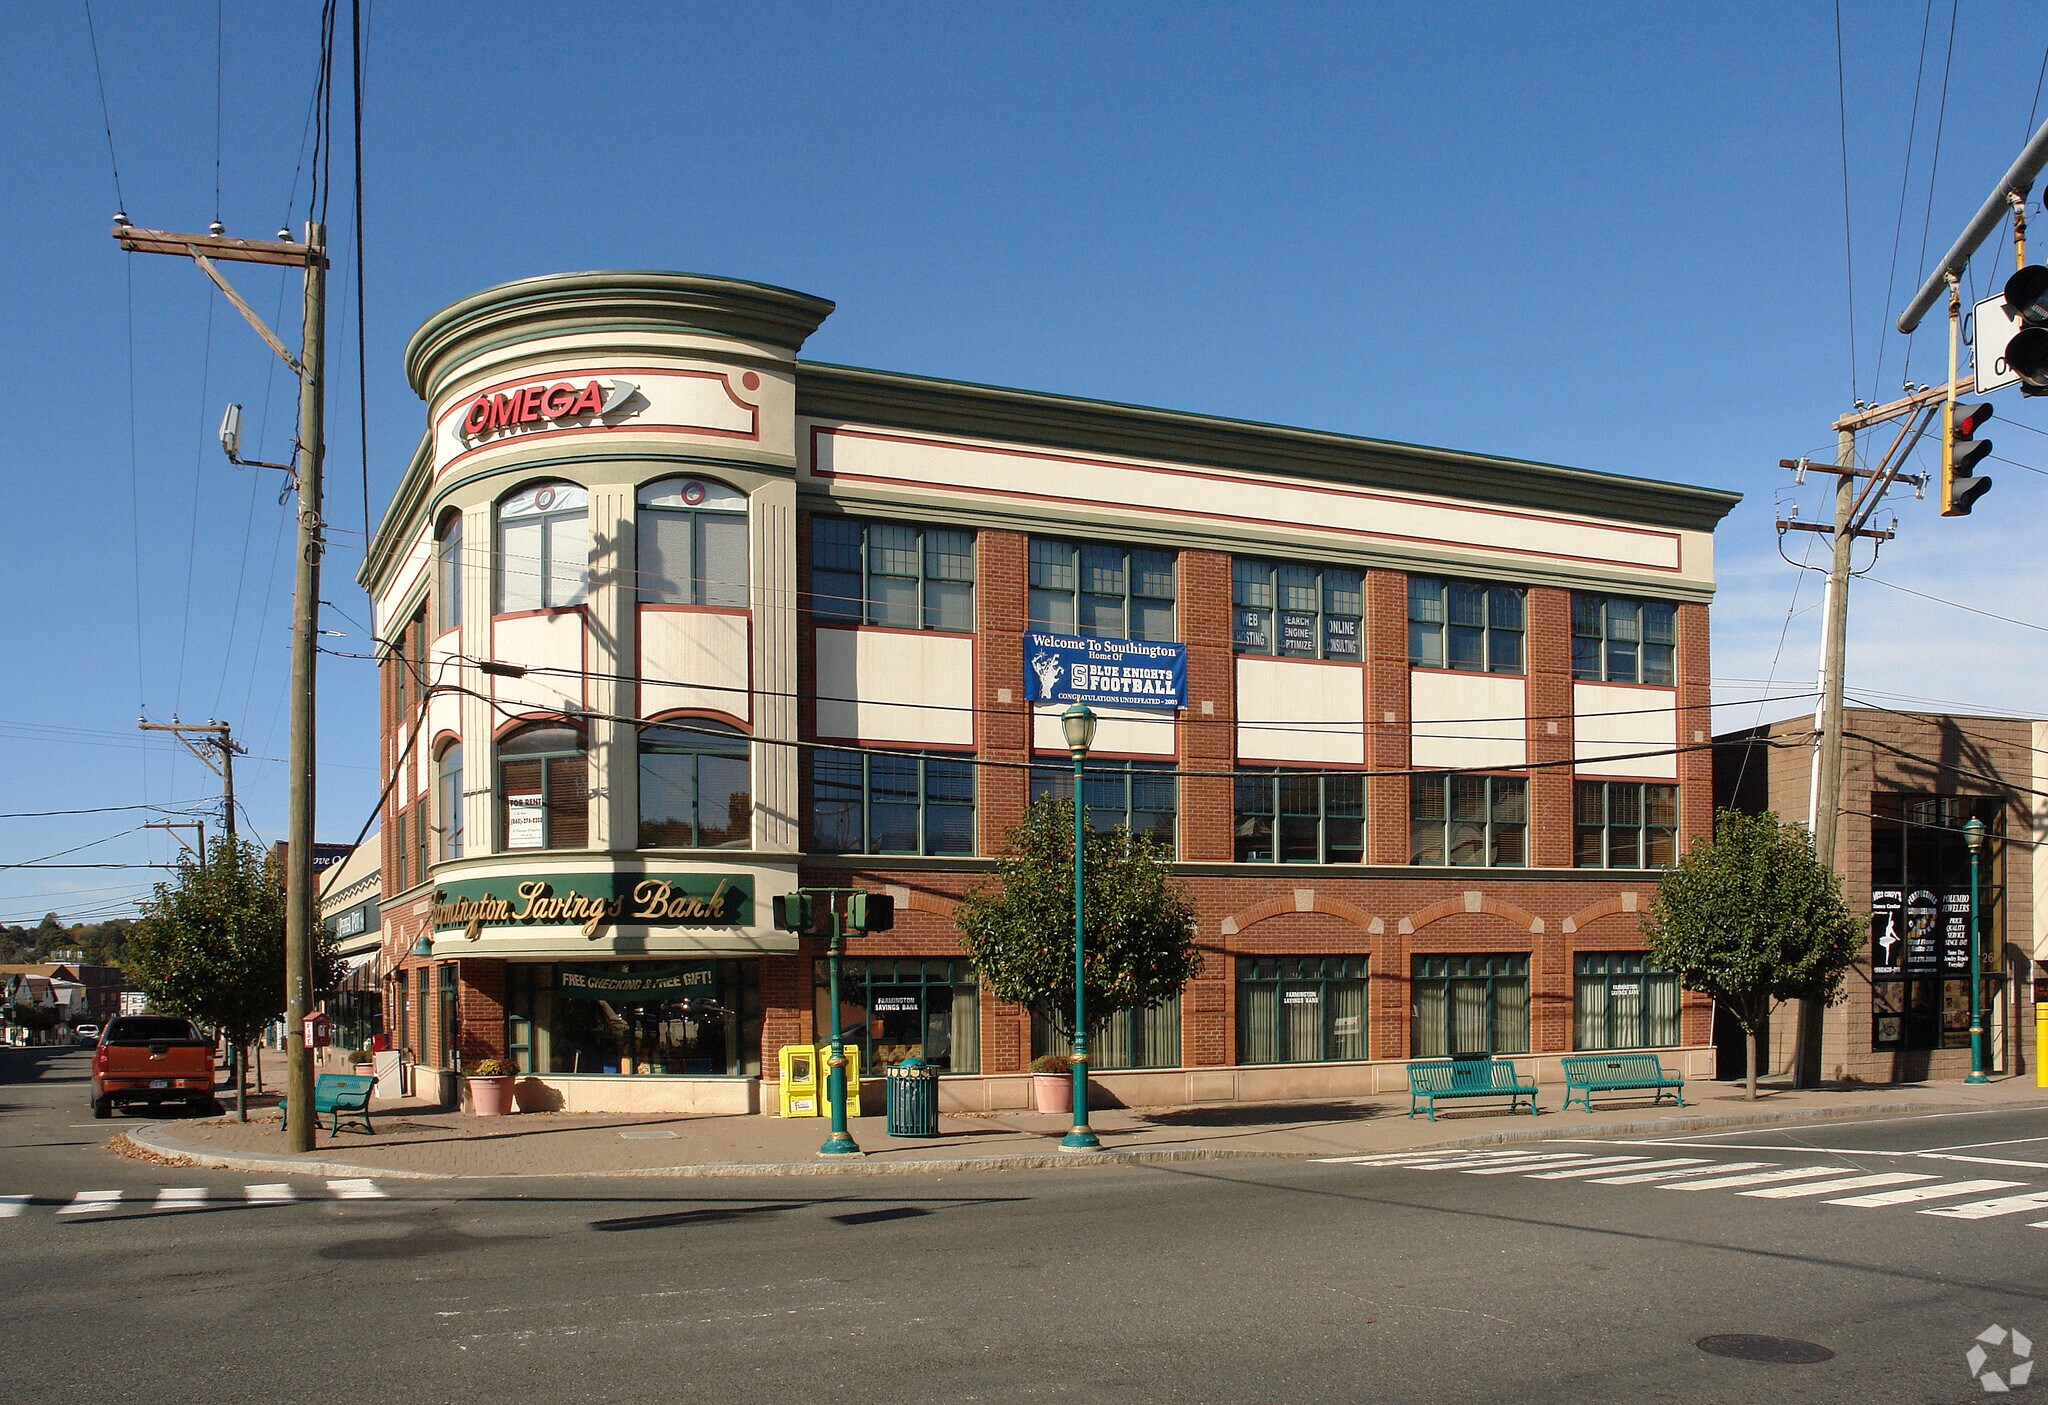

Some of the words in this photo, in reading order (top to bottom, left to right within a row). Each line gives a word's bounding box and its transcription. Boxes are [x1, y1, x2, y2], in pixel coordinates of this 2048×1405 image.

[466, 380, 603, 433] OMEGA
[1241, 612, 1258, 626] WEB
[1283, 615, 1310, 626] SEARCH
[1284, 627, 1309, 638] ENGINE
[1328, 620, 1355, 635] ONLINE
[1032, 634, 1085, 650] Welcome
[1087, 639, 1102, 652] To
[1104, 641, 1177, 658] Southington
[1281, 639, 1313, 650] OPTIMIZE
[1088, 651, 1111, 661] Home
[1112, 653, 1123, 662] Of
[1072, 664, 1088, 688] S
[1090, 665, 1120, 678] BLUE
[1122, 667, 1173, 680] KNIGHTS
[1089, 676, 1176, 695] FOOTBALL
[1058, 692, 1120, 704] CONGRATULATIONS
[1119, 697, 1160, 705] UNDEFEATED
[509, 799, 524, 807] FOR
[525, 798, 542, 806] RENT
[512, 880, 624, 937] Savings
[631, 878, 726, 919] Bank
[1941, 904, 1970, 913] JEWELERS
[1982, 952, 1994, 963] 26
[562, 972, 586, 987] FREE
[587, 976, 642, 990] CHECKING
[642, 979, 652, 989] &
[652, 976, 681, 988] FREE
[682, 970, 712, 986] GIFT!
